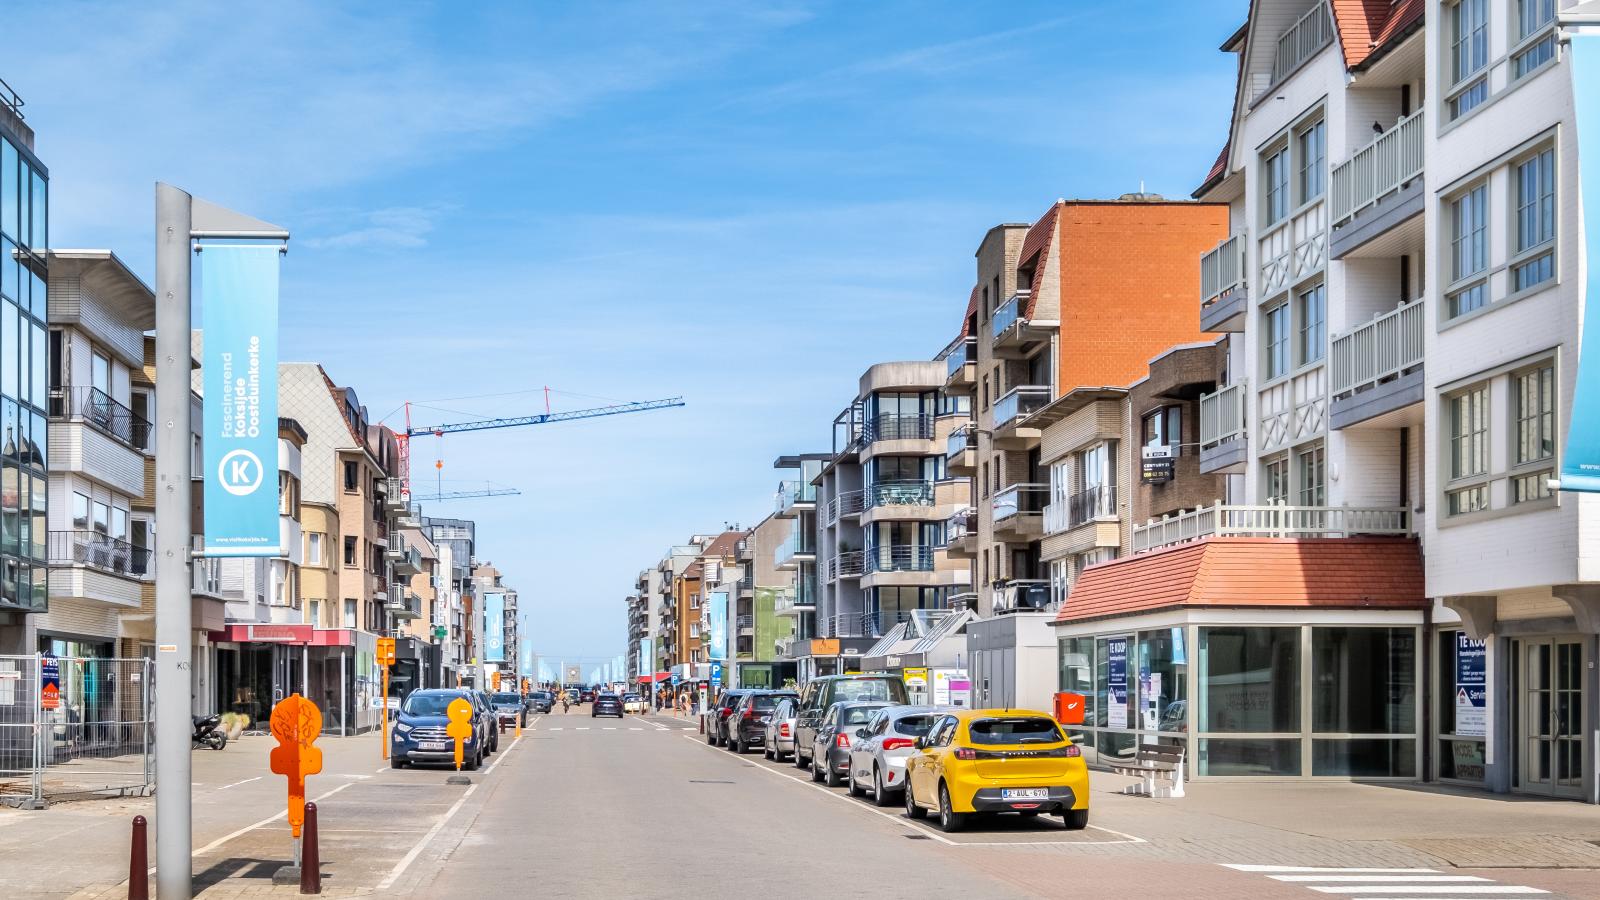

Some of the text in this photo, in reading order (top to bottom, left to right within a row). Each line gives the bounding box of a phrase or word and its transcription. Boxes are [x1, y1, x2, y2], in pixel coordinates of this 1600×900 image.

[222, 352, 232, 438] Fascinerend
[248, 336, 260, 438] Oostduinkerke
[234, 378, 247, 438] Koksijde
[232, 461, 250, 482] K
[46, 658, 58, 666] FEYS
[713, 665, 720, 675] P
